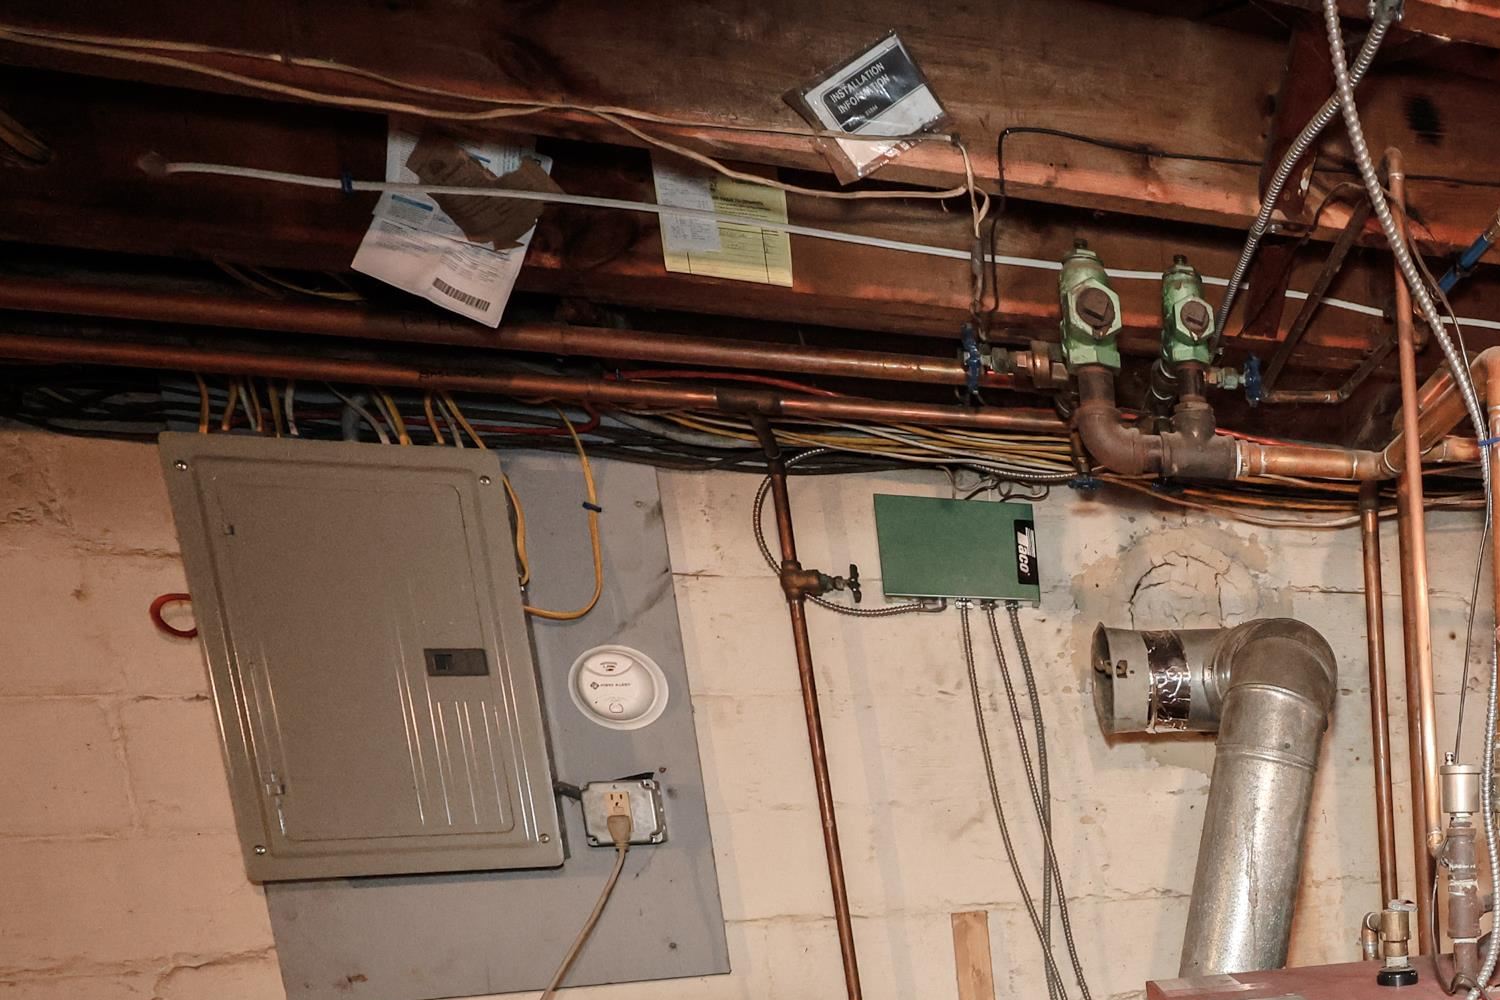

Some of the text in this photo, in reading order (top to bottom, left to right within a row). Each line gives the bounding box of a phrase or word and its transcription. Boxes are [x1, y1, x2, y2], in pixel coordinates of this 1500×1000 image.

[830, 62, 886, 103] INSTALLATION
[836, 73, 891, 114] INFORMATION
[1016, 526, 1036, 574] Taco
